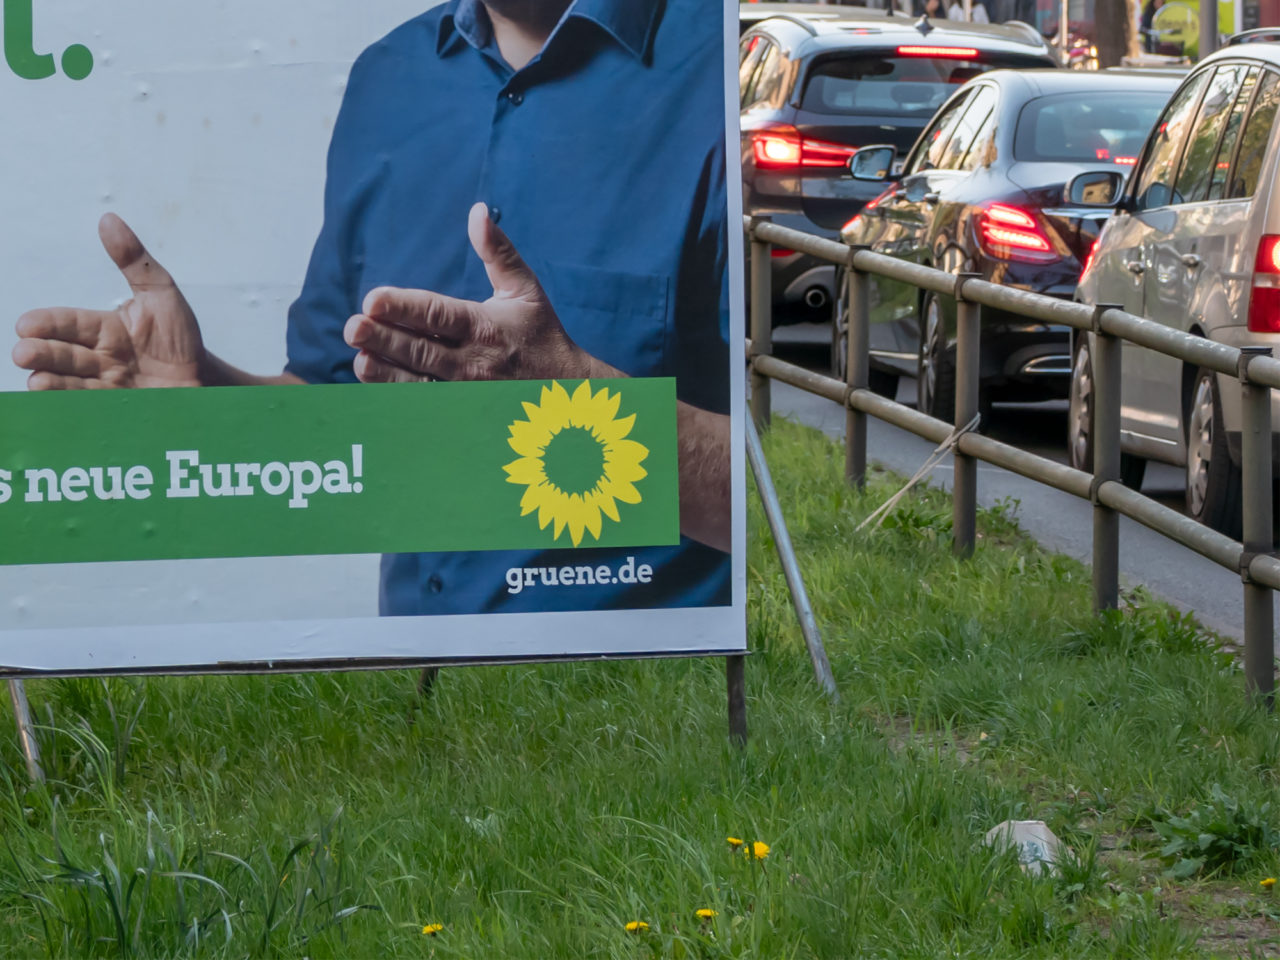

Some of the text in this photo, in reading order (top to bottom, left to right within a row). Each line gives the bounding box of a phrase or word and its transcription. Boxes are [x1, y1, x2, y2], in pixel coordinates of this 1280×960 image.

[25, 466, 153, 502] neue
[166, 445, 363, 508] Europa!
[505, 556, 653, 594] gruene.de
